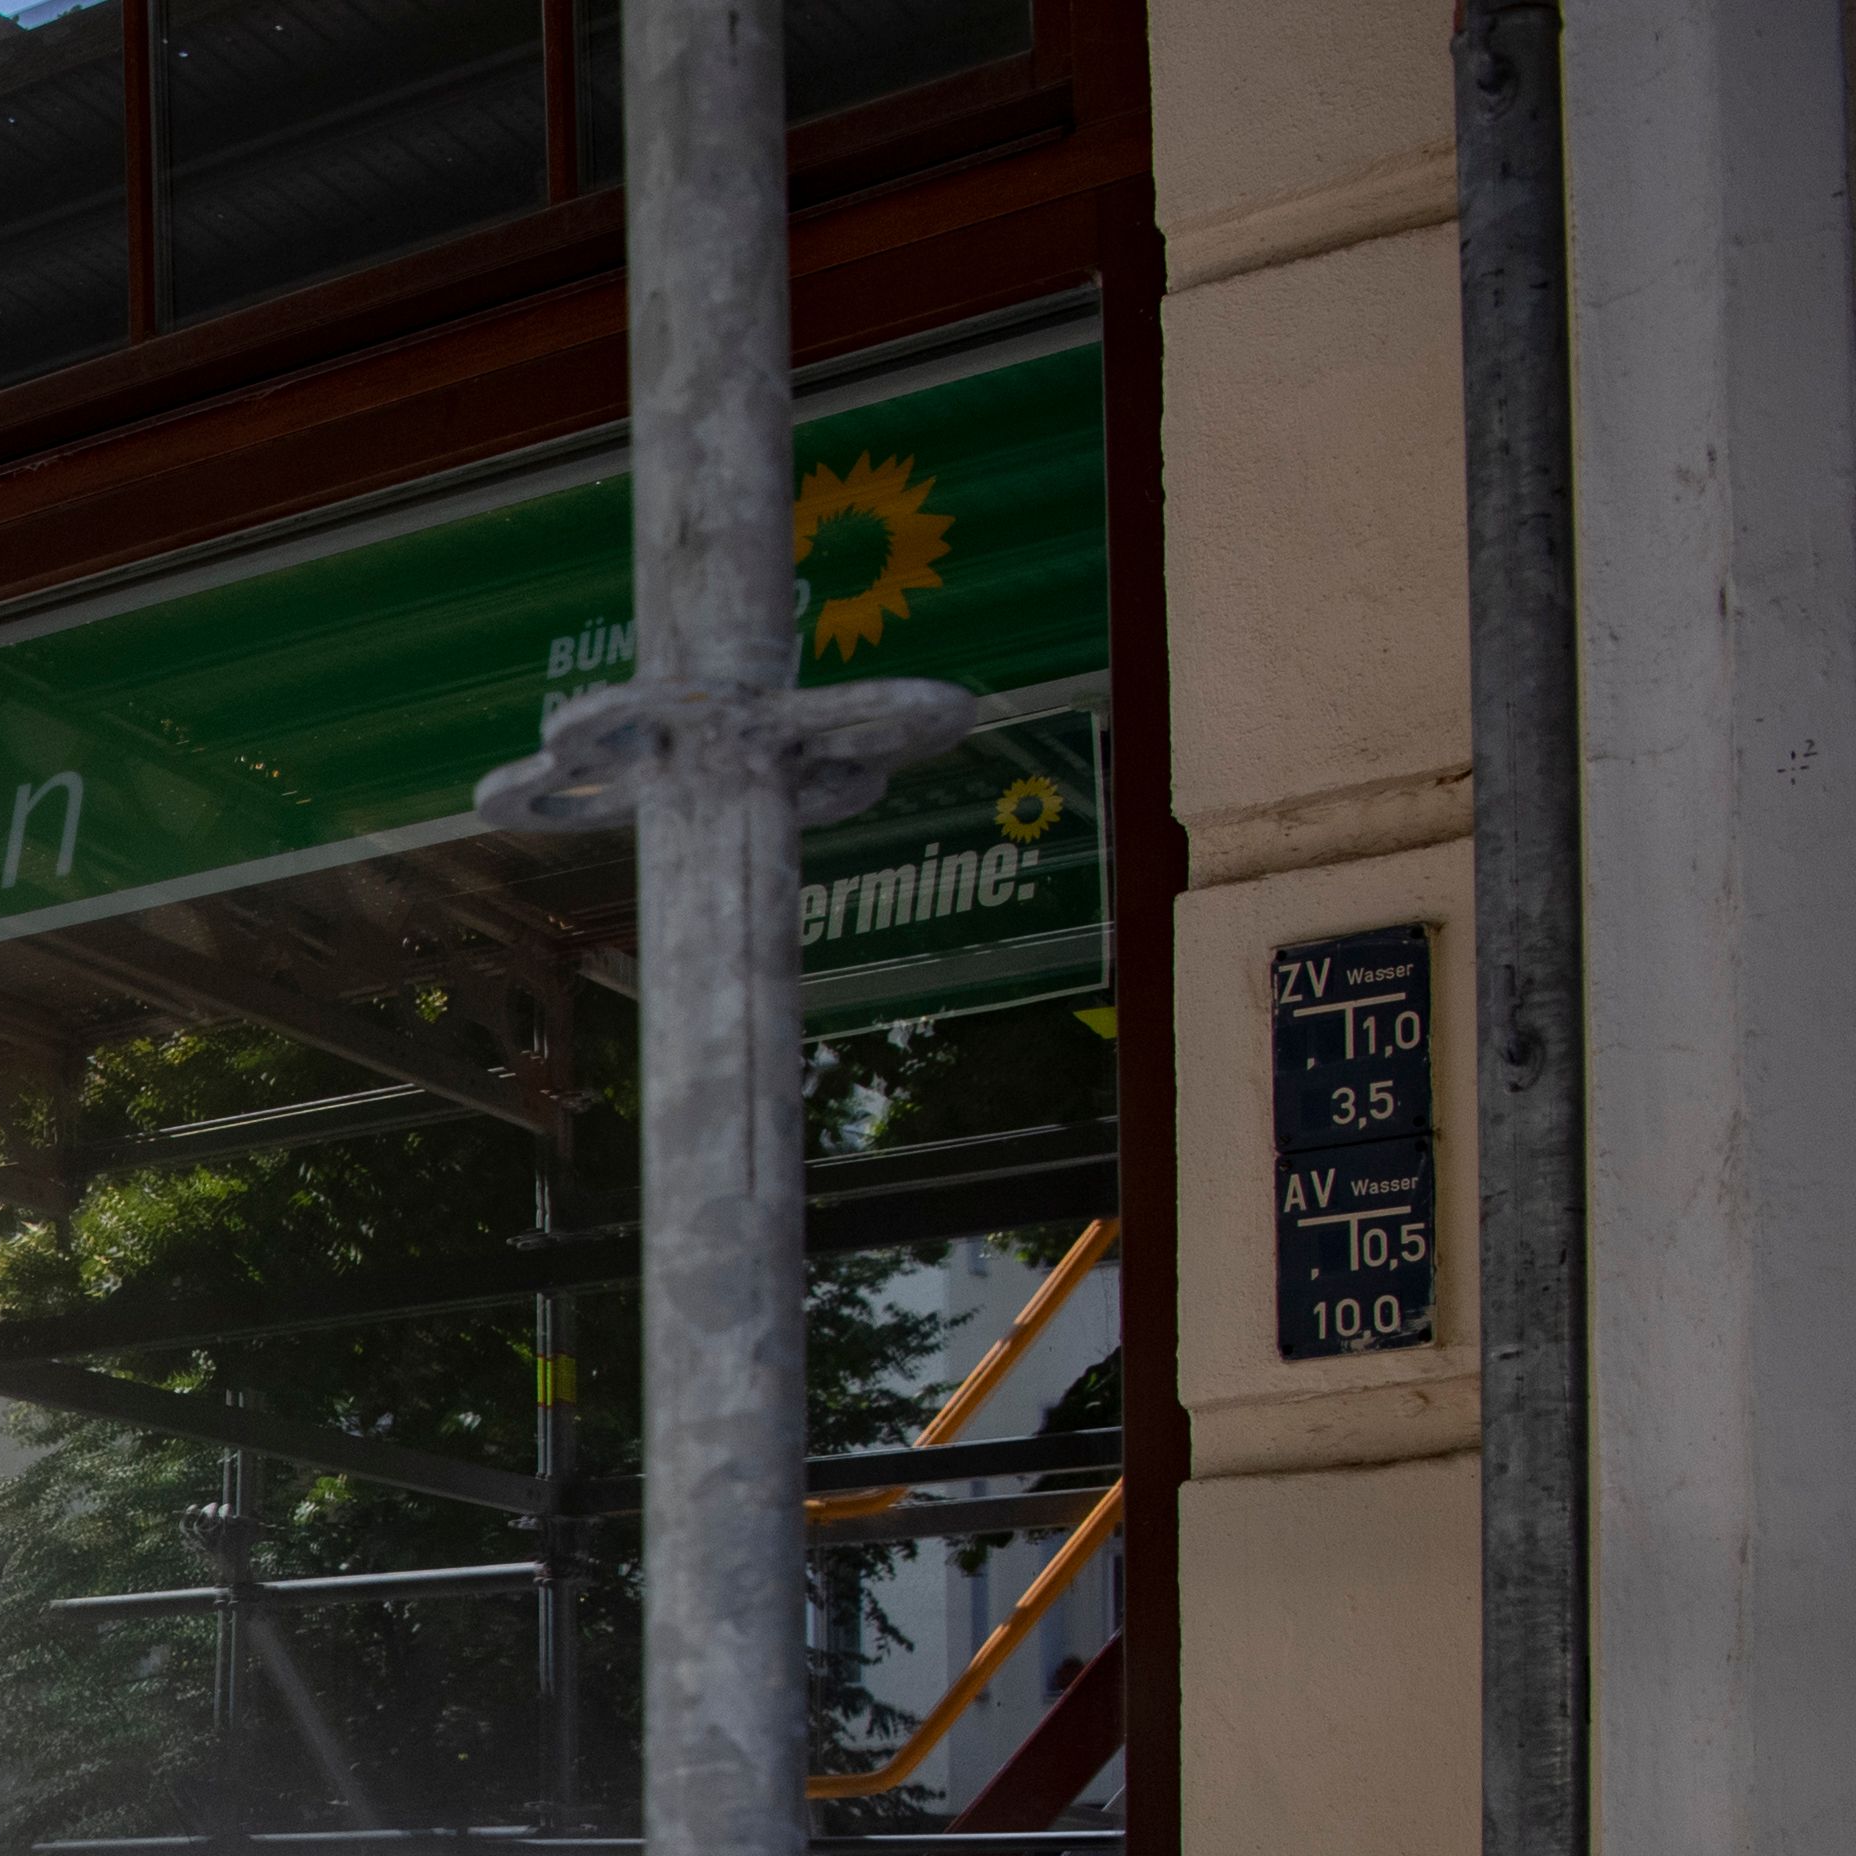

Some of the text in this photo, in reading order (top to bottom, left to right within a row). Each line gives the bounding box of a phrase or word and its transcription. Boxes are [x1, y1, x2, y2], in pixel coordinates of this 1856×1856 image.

[799, 841, 1040, 950] ermine:
[1277, 956, 1415, 1004] ZV Wasser
[1331, 1080, 1395, 1130] 3,5
[1283, 1167, 1420, 1213] AV Wasser
